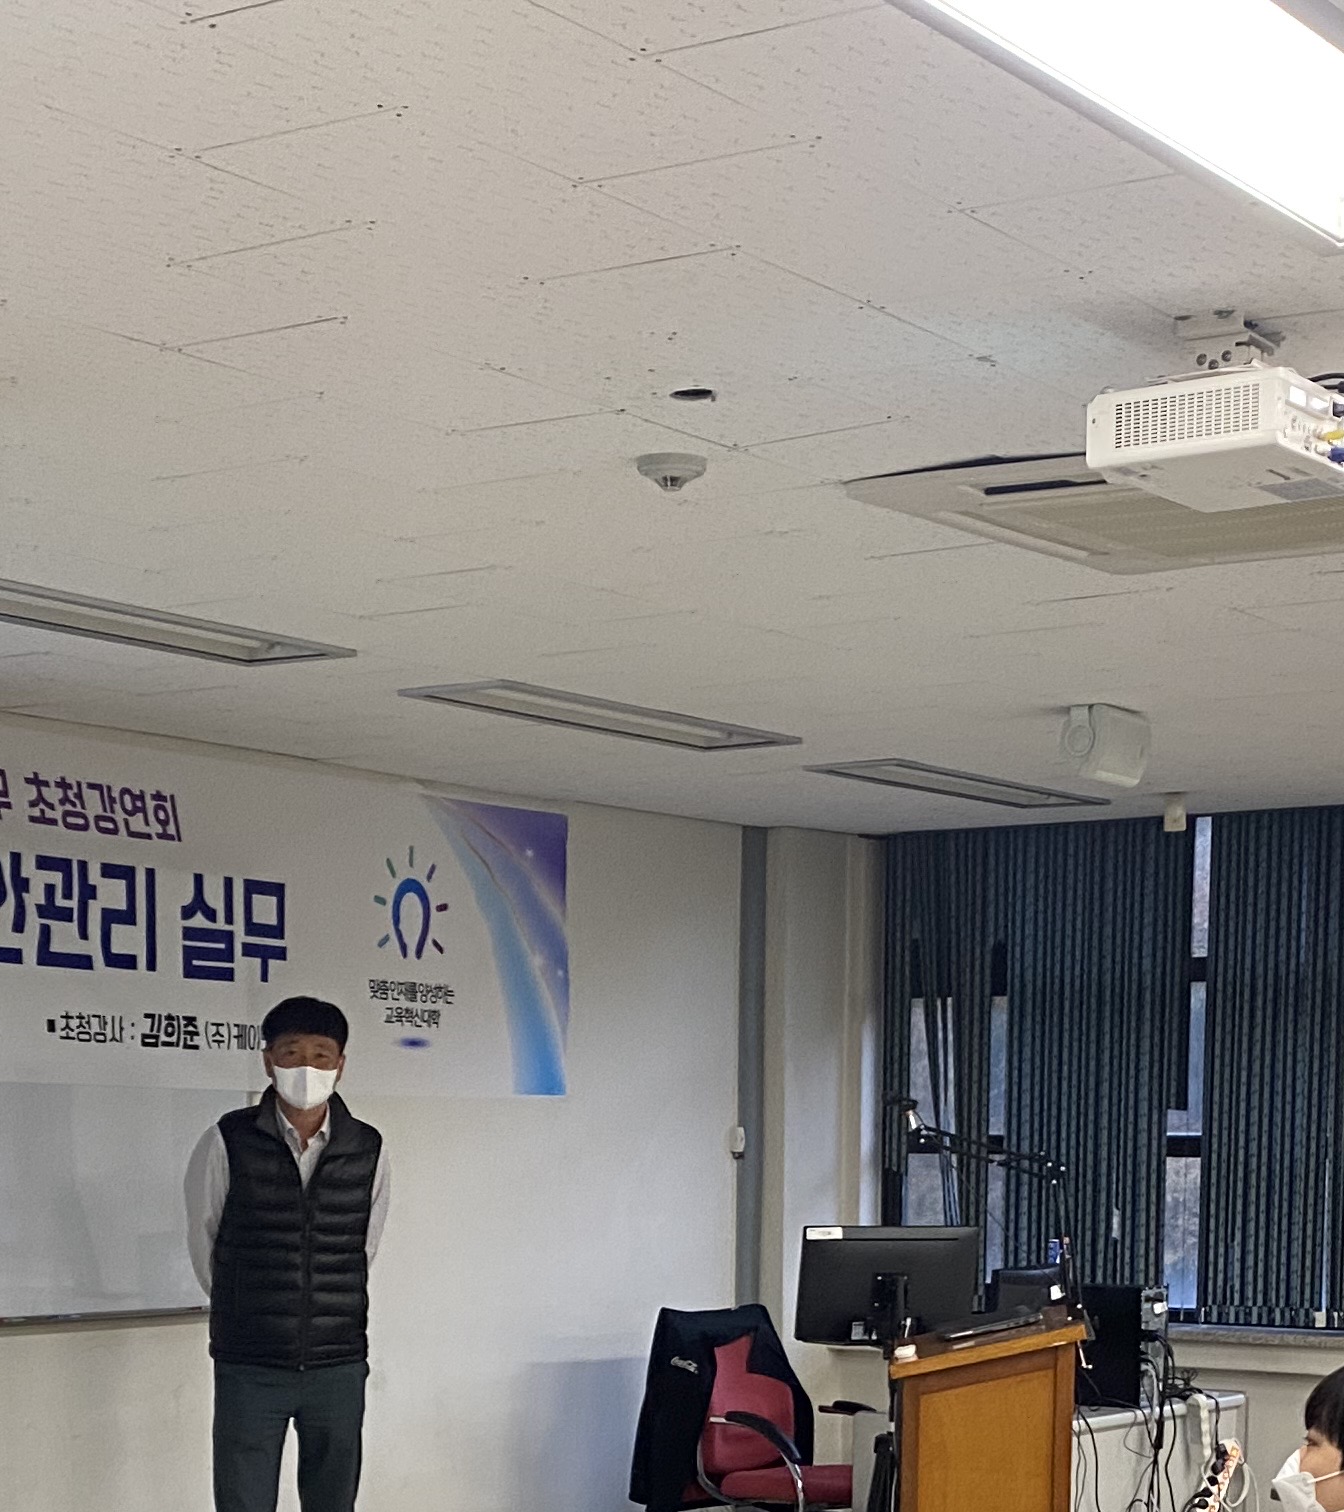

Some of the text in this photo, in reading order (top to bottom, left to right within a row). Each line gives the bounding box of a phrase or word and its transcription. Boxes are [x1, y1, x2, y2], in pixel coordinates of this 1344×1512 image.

[23, 771, 182, 842] 초청강연회
[180, 872, 287, 983] 실무
[59, 1011, 124, 1043] 초청강사
[141, 1013, 200, 1050] 김희준
[205, 1021, 265, 1052] (주)케이
[384, 1006, 441, 1029] 교육혁신대학
